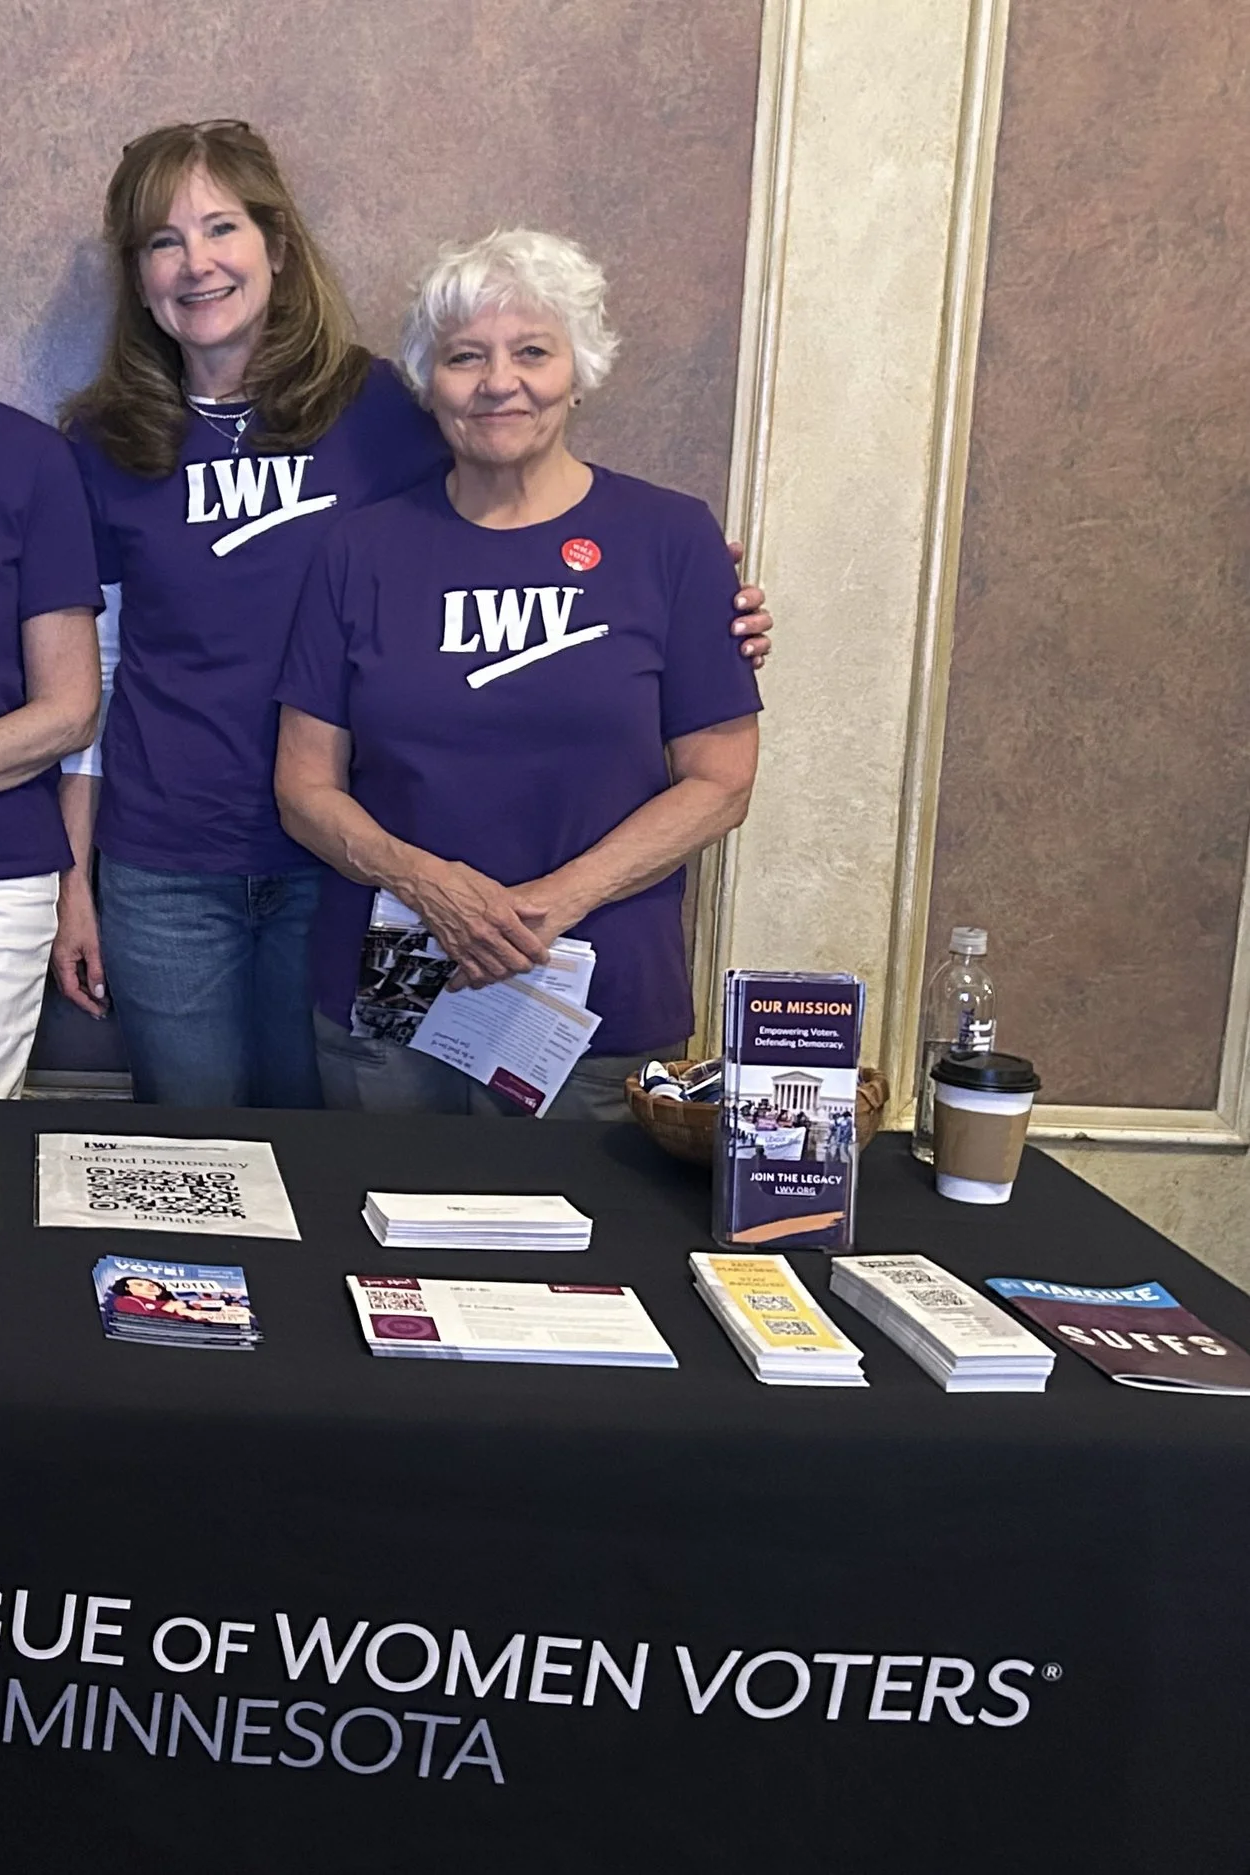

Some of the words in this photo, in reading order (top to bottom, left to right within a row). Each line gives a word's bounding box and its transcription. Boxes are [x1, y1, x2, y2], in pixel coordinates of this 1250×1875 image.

[185, 455, 309, 523] LWV
[439, 587, 580, 652] LWV
[750, 1000, 783, 1013] OUR
[786, 1001, 852, 1015] MISSION
[759, 1026, 809, 1037] Empowering
[810, 1028, 840, 1037] Voters.
[755, 1037, 796, 1048] Defending
[798, 1039, 845, 1050] Democracy.
[84, 1142, 118, 1150] LWV
[70, 1155, 137, 1165] Defend
[143, 1159, 249, 1169] Democracy
[750, 1172, 775, 1182] JOIN
[778, 1173, 798, 1183] THE
[801, 1174, 842, 1185] LEGACY
[775, 1186, 816, 1195] LWV.ORG
[134, 1214, 206, 1225] Donate
[115, 1262, 185, 1276] VOTE!
[1021, 1281, 1161, 1302] MARQUEE
[1057, 1324, 1227, 1356] SUFFS
[152, 1617, 255, 1674] OF
[275, 1612, 650, 1712] WOMEN
[2, 1677, 506, 1785] MINNESOTA
